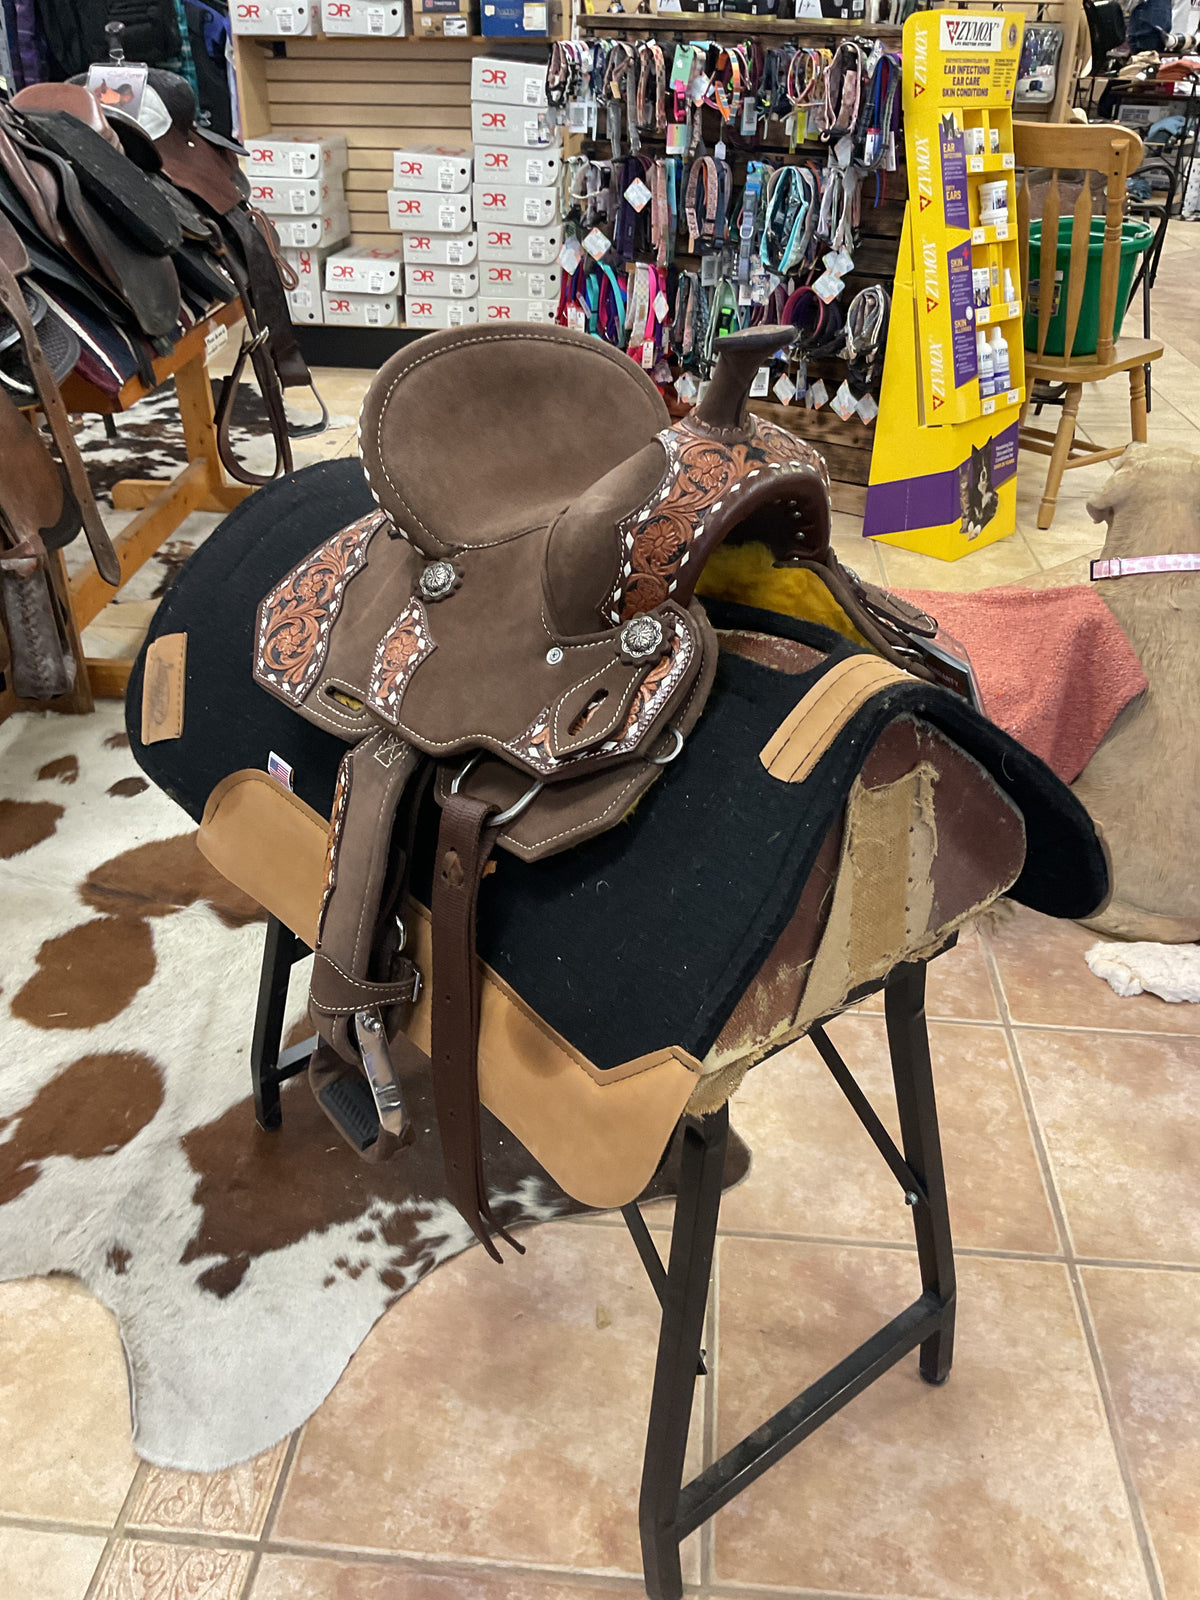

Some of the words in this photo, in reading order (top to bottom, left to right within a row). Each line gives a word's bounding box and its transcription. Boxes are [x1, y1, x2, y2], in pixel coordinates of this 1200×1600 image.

[956, 21, 996, 41] ZYMOX
[914, 30, 928, 84] ZYMOX
[944, 65, 956, 75] EAR
[957, 66, 990, 75] INFECTIONS
[952, 77, 964, 86] EAR
[965, 77, 980, 86] CARE
[942, 88, 955, 97] SKIN
[956, 88, 988, 97] CONDITIONS
[943, 143, 955, 152] EAR
[915, 138, 932, 196] ZYMOX
[946, 190, 961, 201] EARS
[923, 243, 939, 298] ZYMOX
[929, 344, 945, 397] ZYMOX
